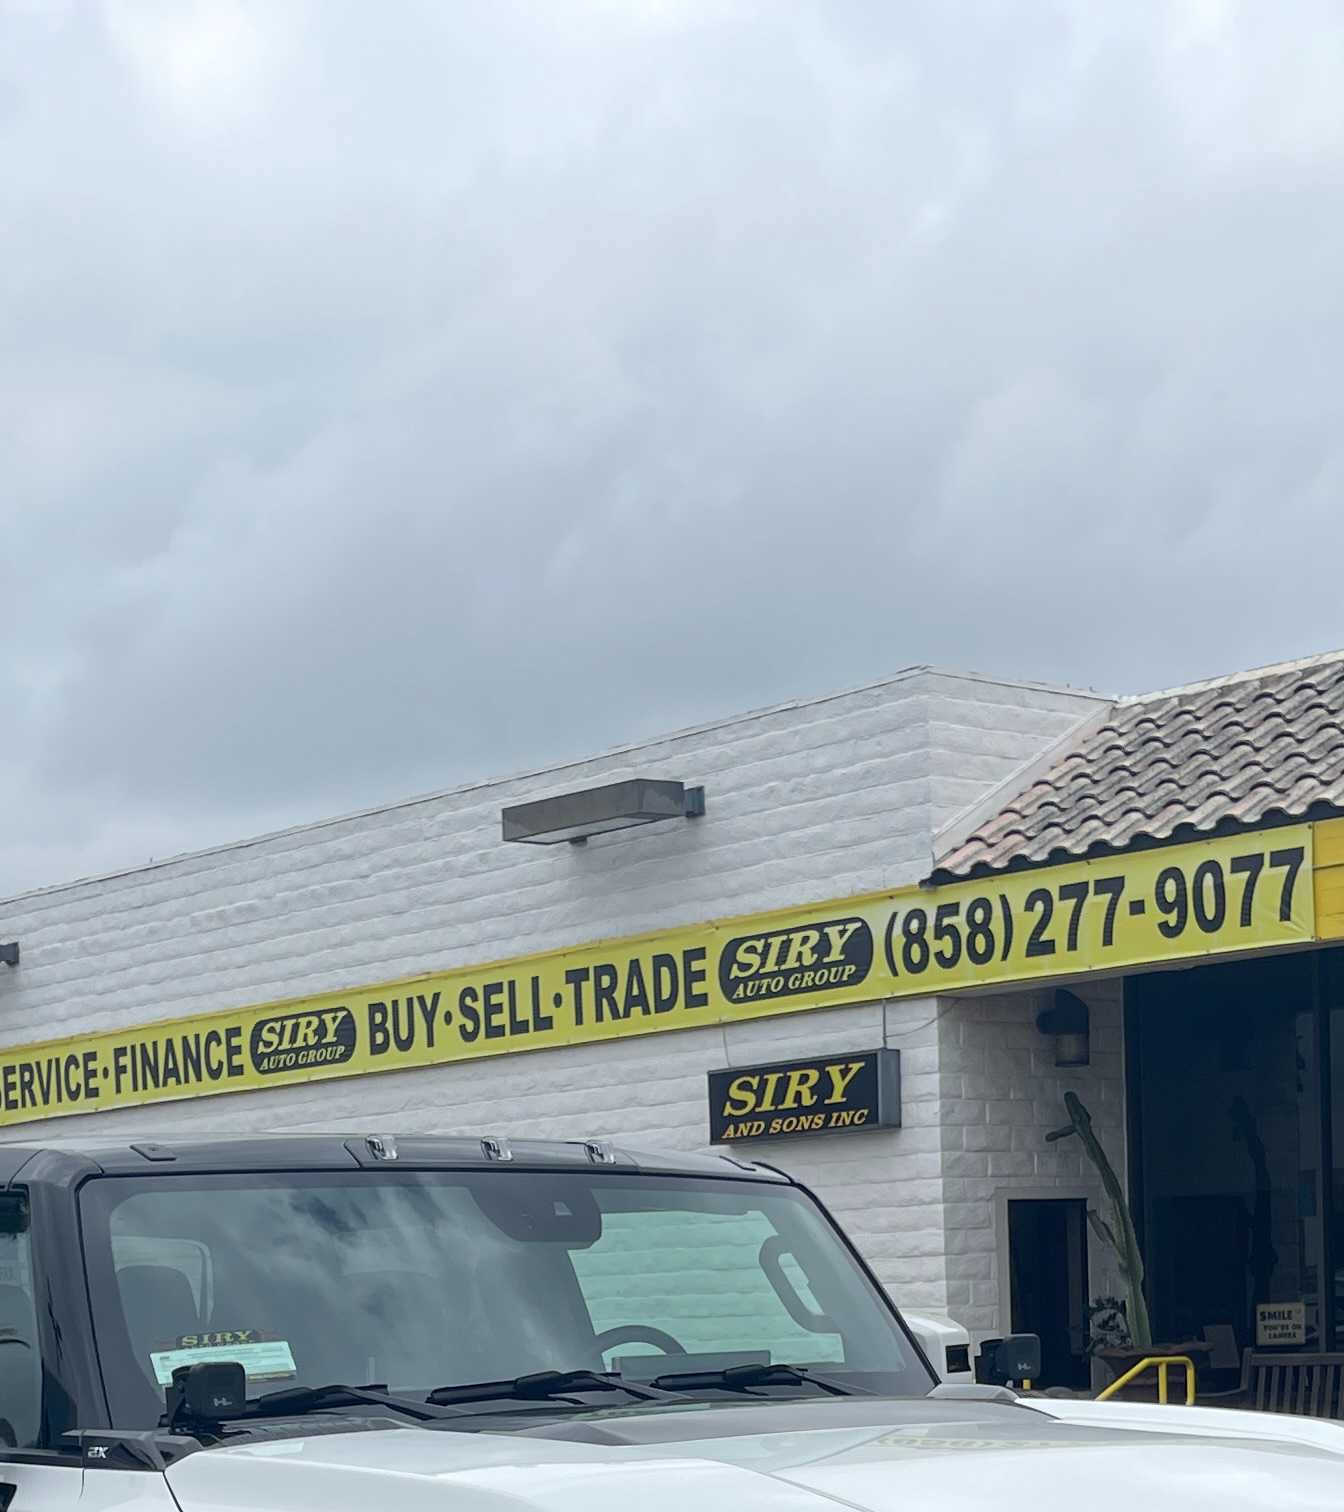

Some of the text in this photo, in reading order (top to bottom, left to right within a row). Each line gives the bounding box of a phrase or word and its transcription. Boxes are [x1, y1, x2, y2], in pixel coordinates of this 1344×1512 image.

[730, 922, 861, 980] SIRY
[733, 965, 856, 999] AUTO GROUP
[368, 947, 709, 1056] BUY SELL TRADE
[257, 1011, 348, 1054] SIRY
[113, 1026, 244, 1094] FINANCE
[260, 1045, 346, 1071] AUTO GROUP
[723, 1062, 865, 1117] SIRY
[721, 1109, 868, 1139] AND SONS INC
[1259, 1310, 1293, 1322] SMILE
[181, 1331, 252, 1346] SIRY
